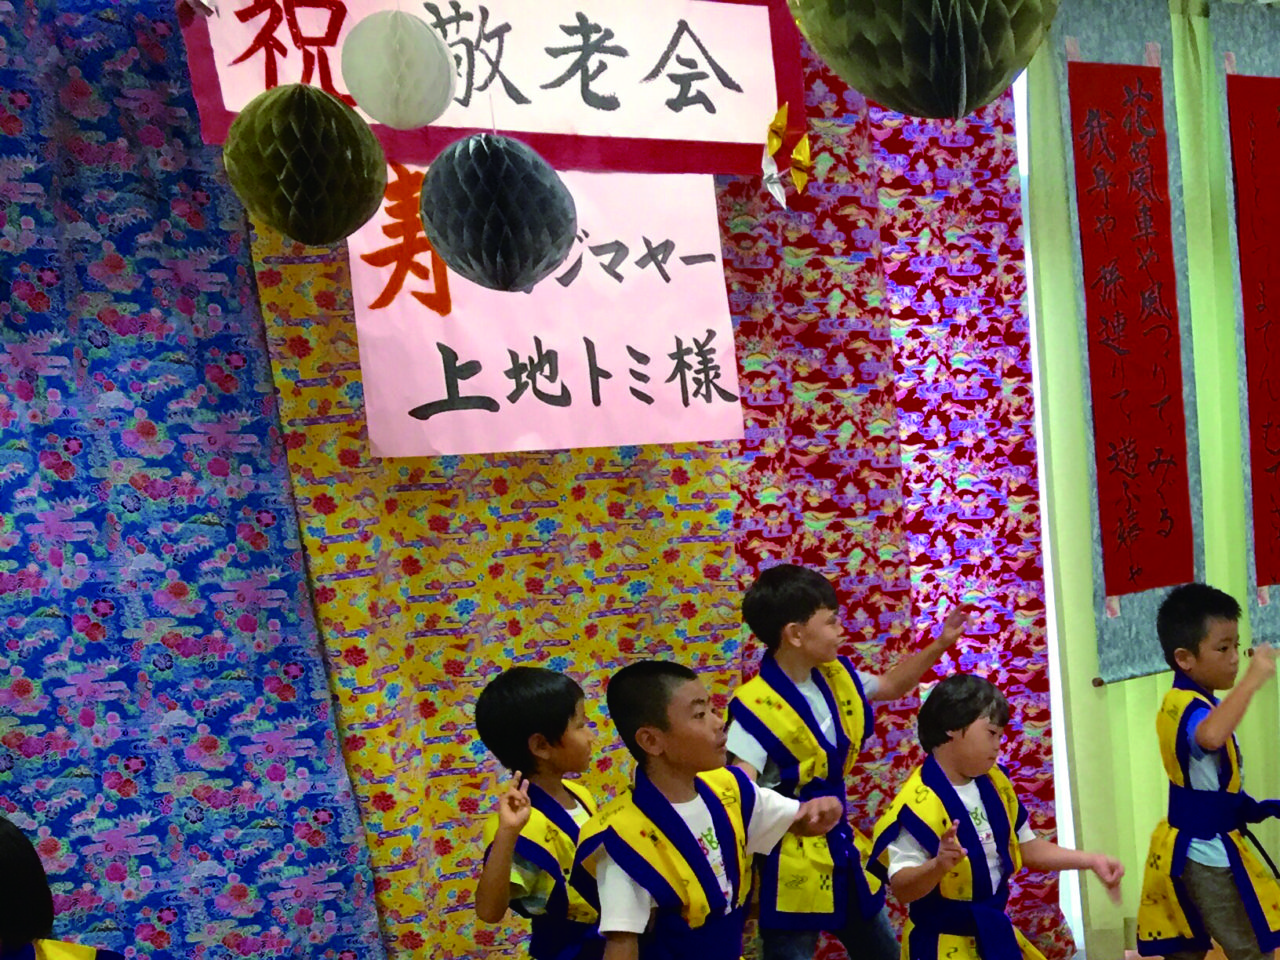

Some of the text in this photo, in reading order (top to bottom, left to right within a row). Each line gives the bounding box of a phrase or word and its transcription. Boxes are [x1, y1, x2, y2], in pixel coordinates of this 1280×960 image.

[227, 0, 358, 107] 祝
[407, 328, 740, 421] 上地トミ様
